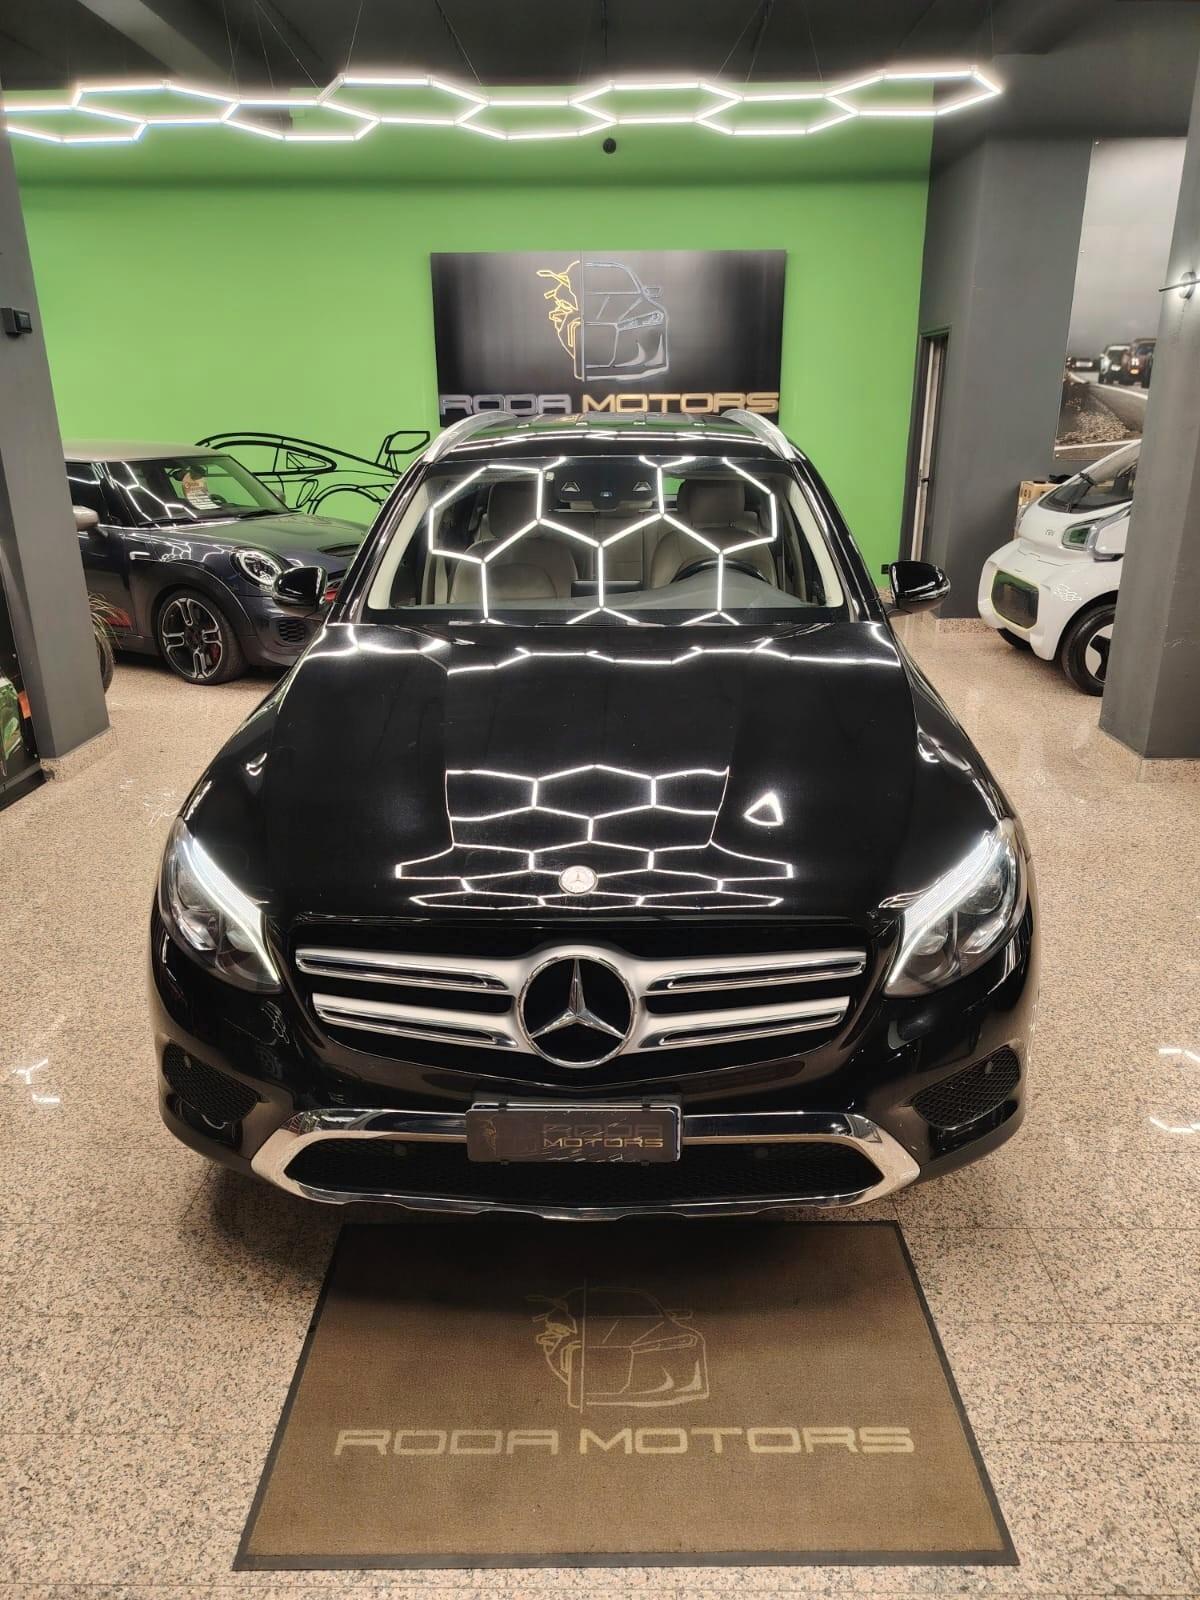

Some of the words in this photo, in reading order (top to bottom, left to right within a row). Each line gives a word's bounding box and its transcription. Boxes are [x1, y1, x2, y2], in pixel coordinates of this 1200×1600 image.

[440, 394, 572, 416] RODA
[582, 392, 779, 414] MOTORS
[543, 1137, 663, 1148] MOTORS
[334, 1429, 559, 1456] RODA
[579, 1426, 915, 1454] MOTORS
